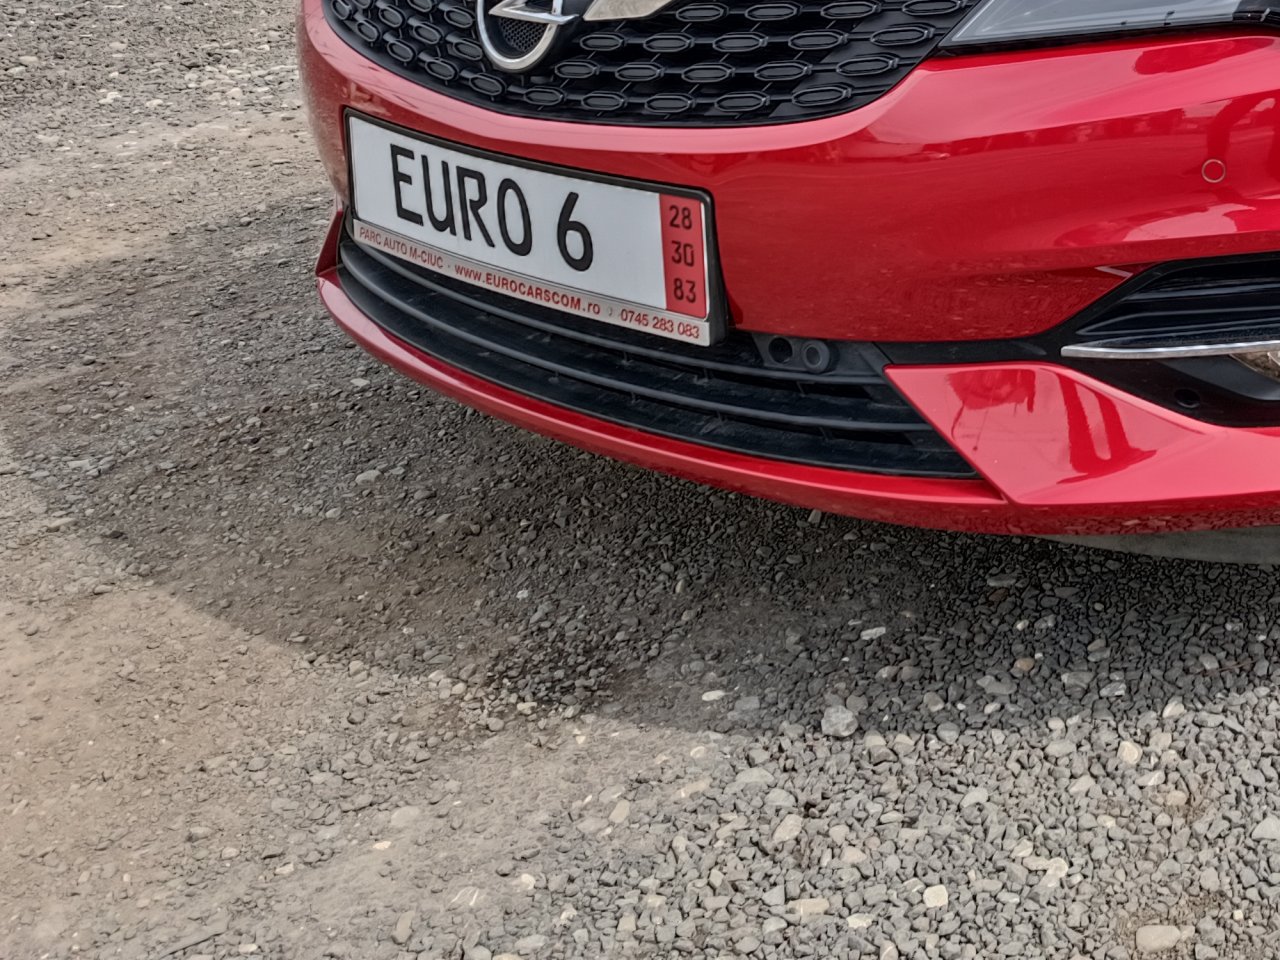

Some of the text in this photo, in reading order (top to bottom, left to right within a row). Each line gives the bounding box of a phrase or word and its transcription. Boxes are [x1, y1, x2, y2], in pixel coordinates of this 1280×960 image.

[390, 143, 593, 271] EURO 6
[669, 205, 692, 230] 28
[671, 240, 695, 267] 30
[359, 226, 382, 246] PARC
[383, 236, 408, 255] AUTO
[409, 246, 445, 269] M-CIUC
[620, 308, 649, 327] 0745
[652, 316, 674, 333] 283
[677, 324, 700, 339] 083
[673, 278, 697, 303] 83
